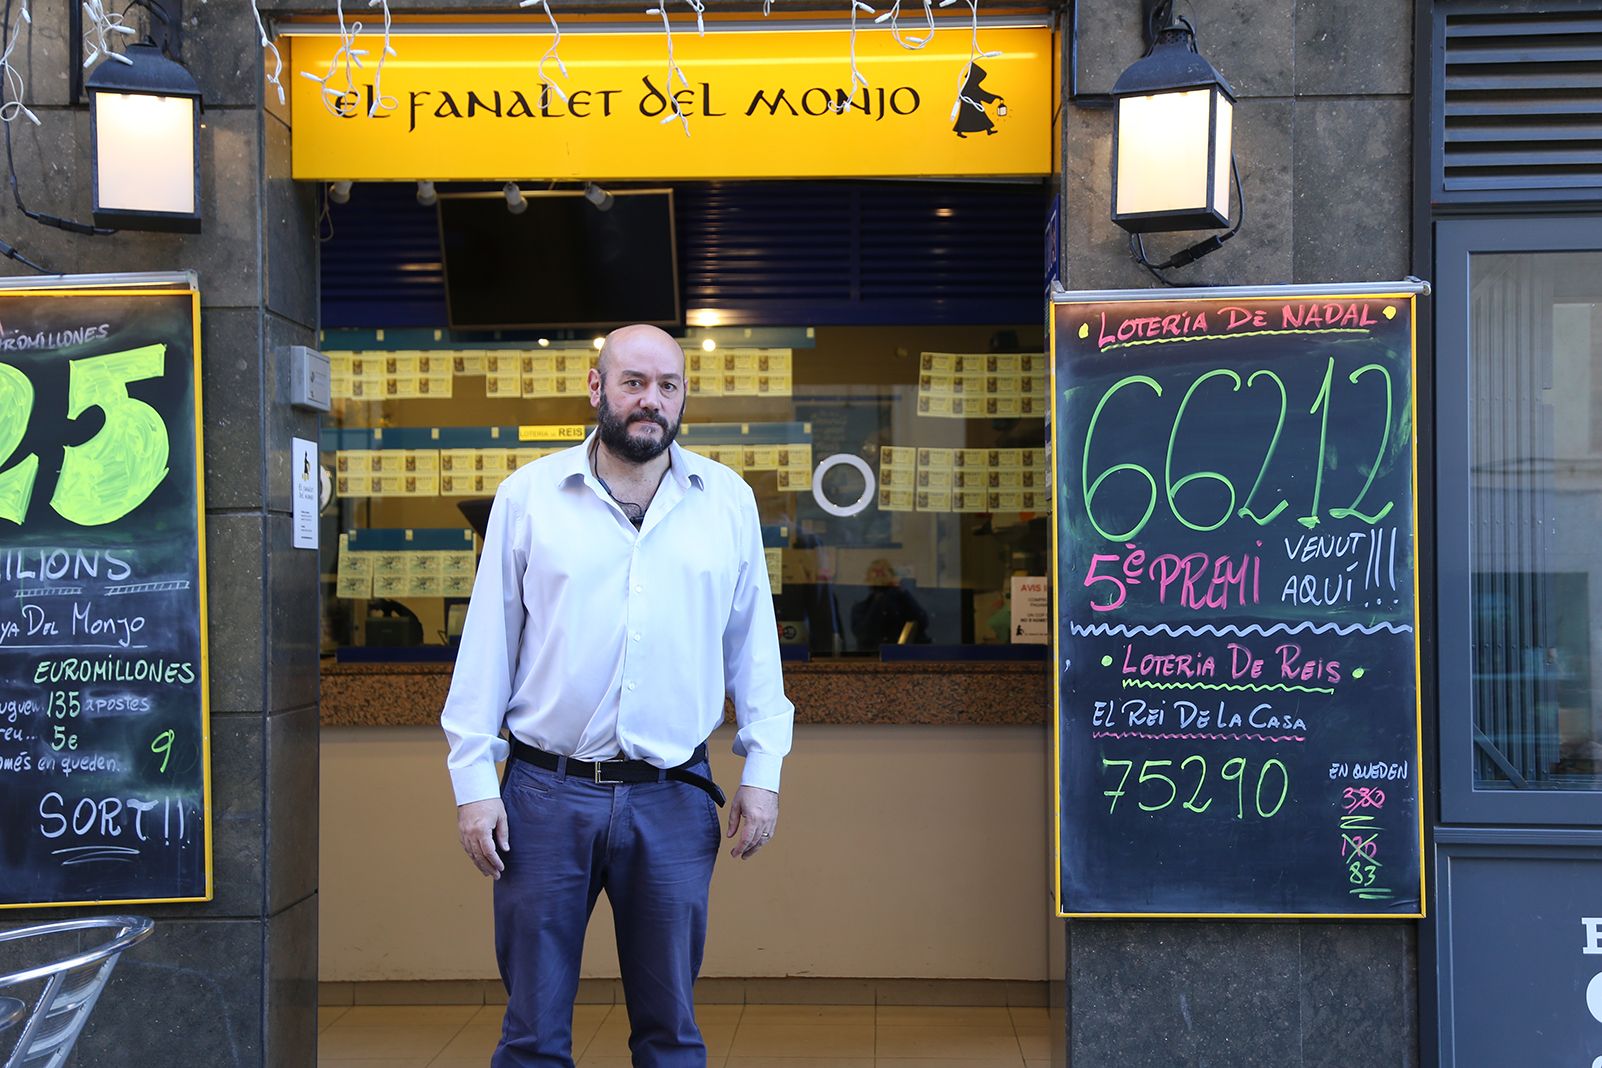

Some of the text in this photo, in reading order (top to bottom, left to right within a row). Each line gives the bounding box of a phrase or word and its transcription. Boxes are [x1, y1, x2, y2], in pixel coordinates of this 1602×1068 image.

[408, 83, 624, 133] FANALET
[639, 75, 727, 117] DEL
[744, 85, 921, 121] MONJO
[1282, 303, 1379, 328] NADAL
[558, 427, 583, 437] REIS
[1082, 356, 1395, 542] 66212
[1284, 532, 1367, 562] VENUT
[0, 548, 131, 581] ILIONS
[1149, 539, 1263, 610] PREMI
[1021, 584, 1041, 593] AVIS
[1275, 644, 1342, 683] REIS
[46, 691, 80, 719] 135
[1092, 701, 1114, 727] EL
[1248, 703, 1307, 731] CASA
[37, 756, 55, 770] en
[151, 729, 175, 773] 9
[1103, 755, 1408, 819] 75290 EN QUEDEN
[1349, 861, 1376, 887] 83
